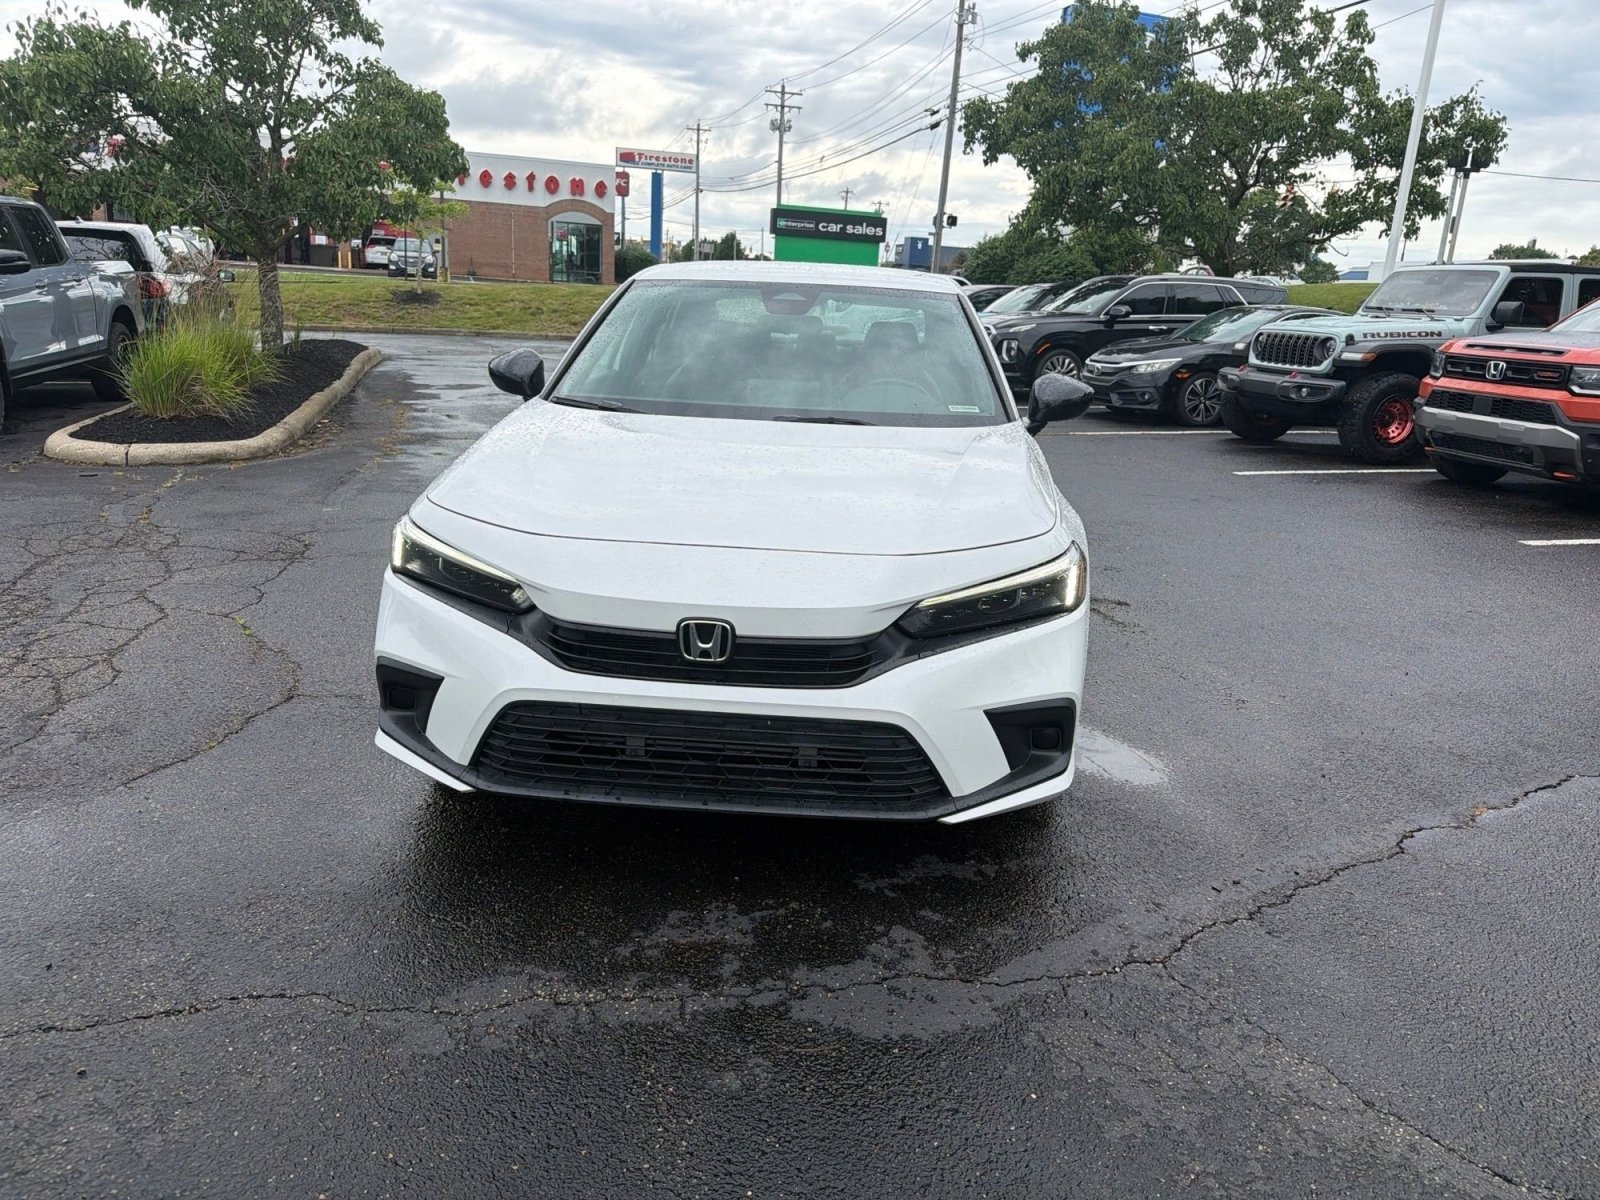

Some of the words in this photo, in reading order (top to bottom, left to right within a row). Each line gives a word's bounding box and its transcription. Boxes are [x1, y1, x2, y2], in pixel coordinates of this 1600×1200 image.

[637, 152, 694, 165] Firestone
[615, 178, 628, 187] FC
[818, 222, 843, 233] car
[845, 222, 883, 236] sales
[1362, 331, 1443, 339] RUBICON
